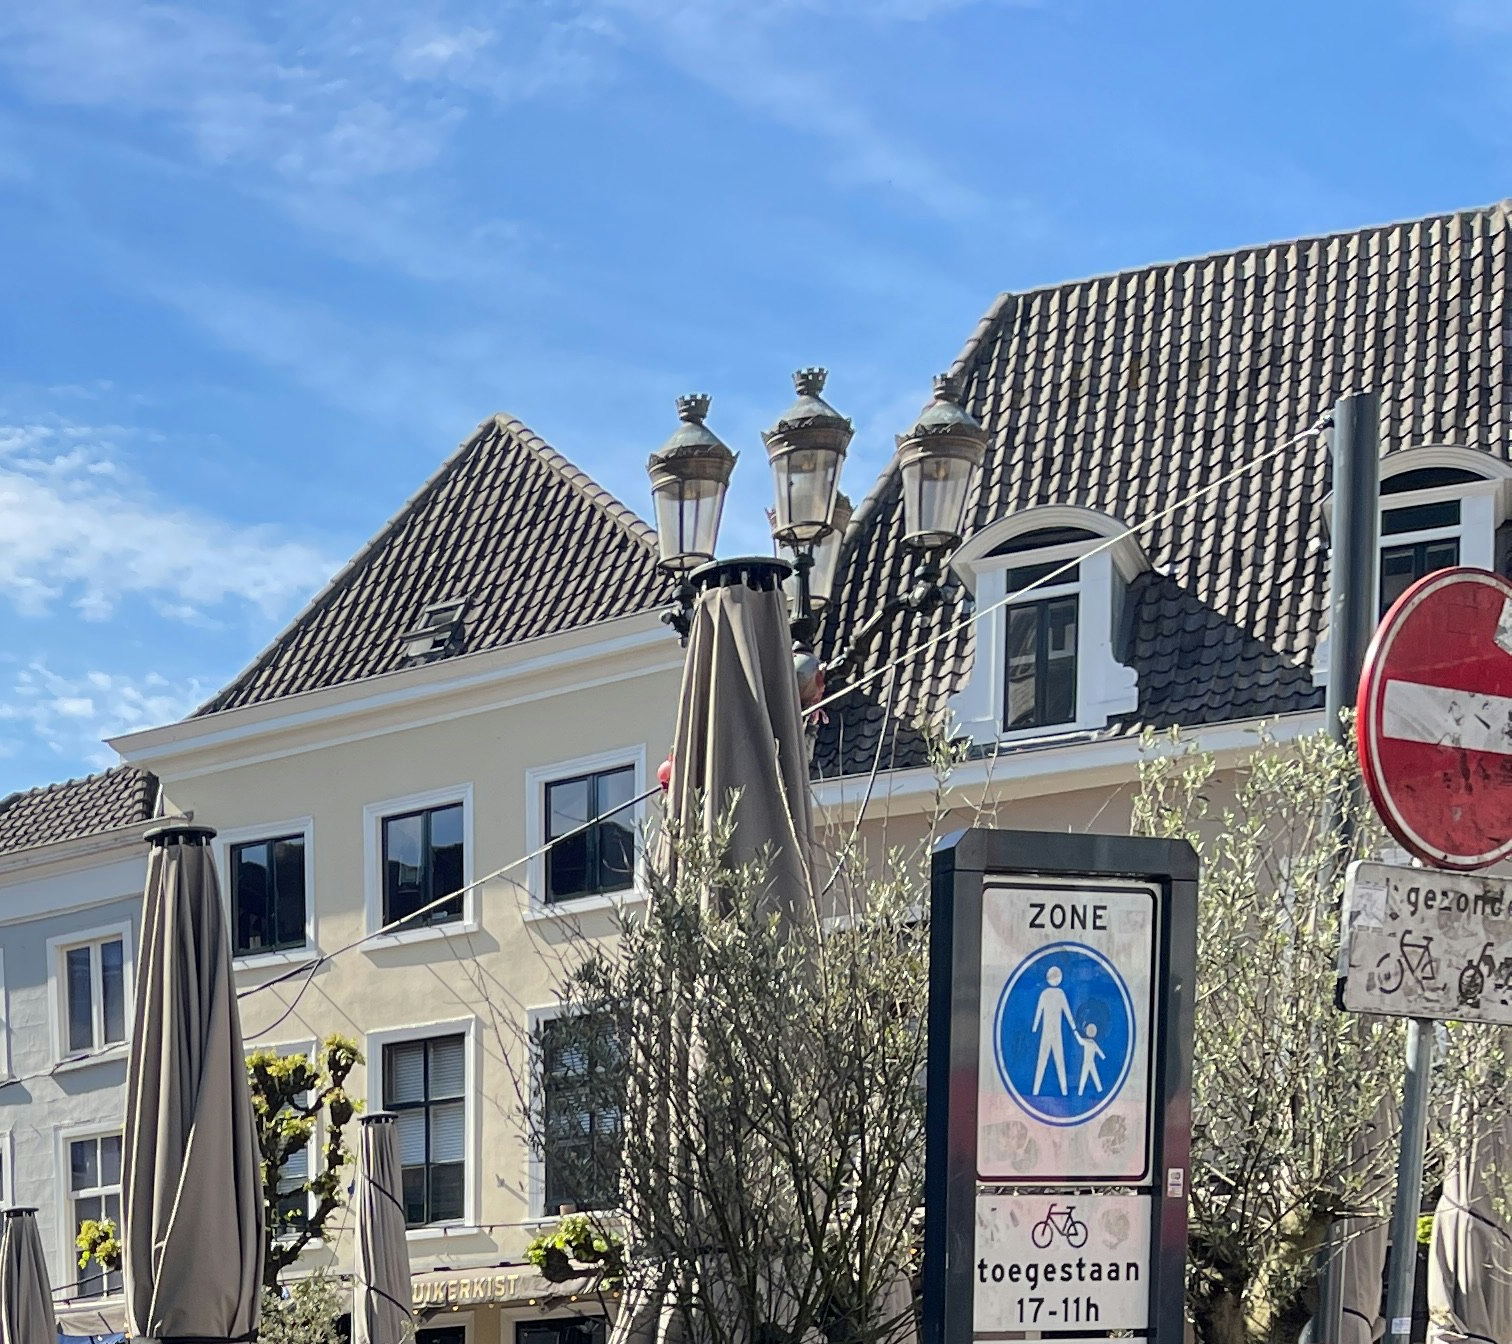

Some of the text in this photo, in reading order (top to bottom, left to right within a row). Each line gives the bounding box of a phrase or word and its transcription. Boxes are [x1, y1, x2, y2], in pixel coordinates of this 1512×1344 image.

[1028, 902, 1108, 931] ZONE
[412, 1274, 520, 1303] UIKERKIST
[977, 1257, 1140, 1291] toegestaan
